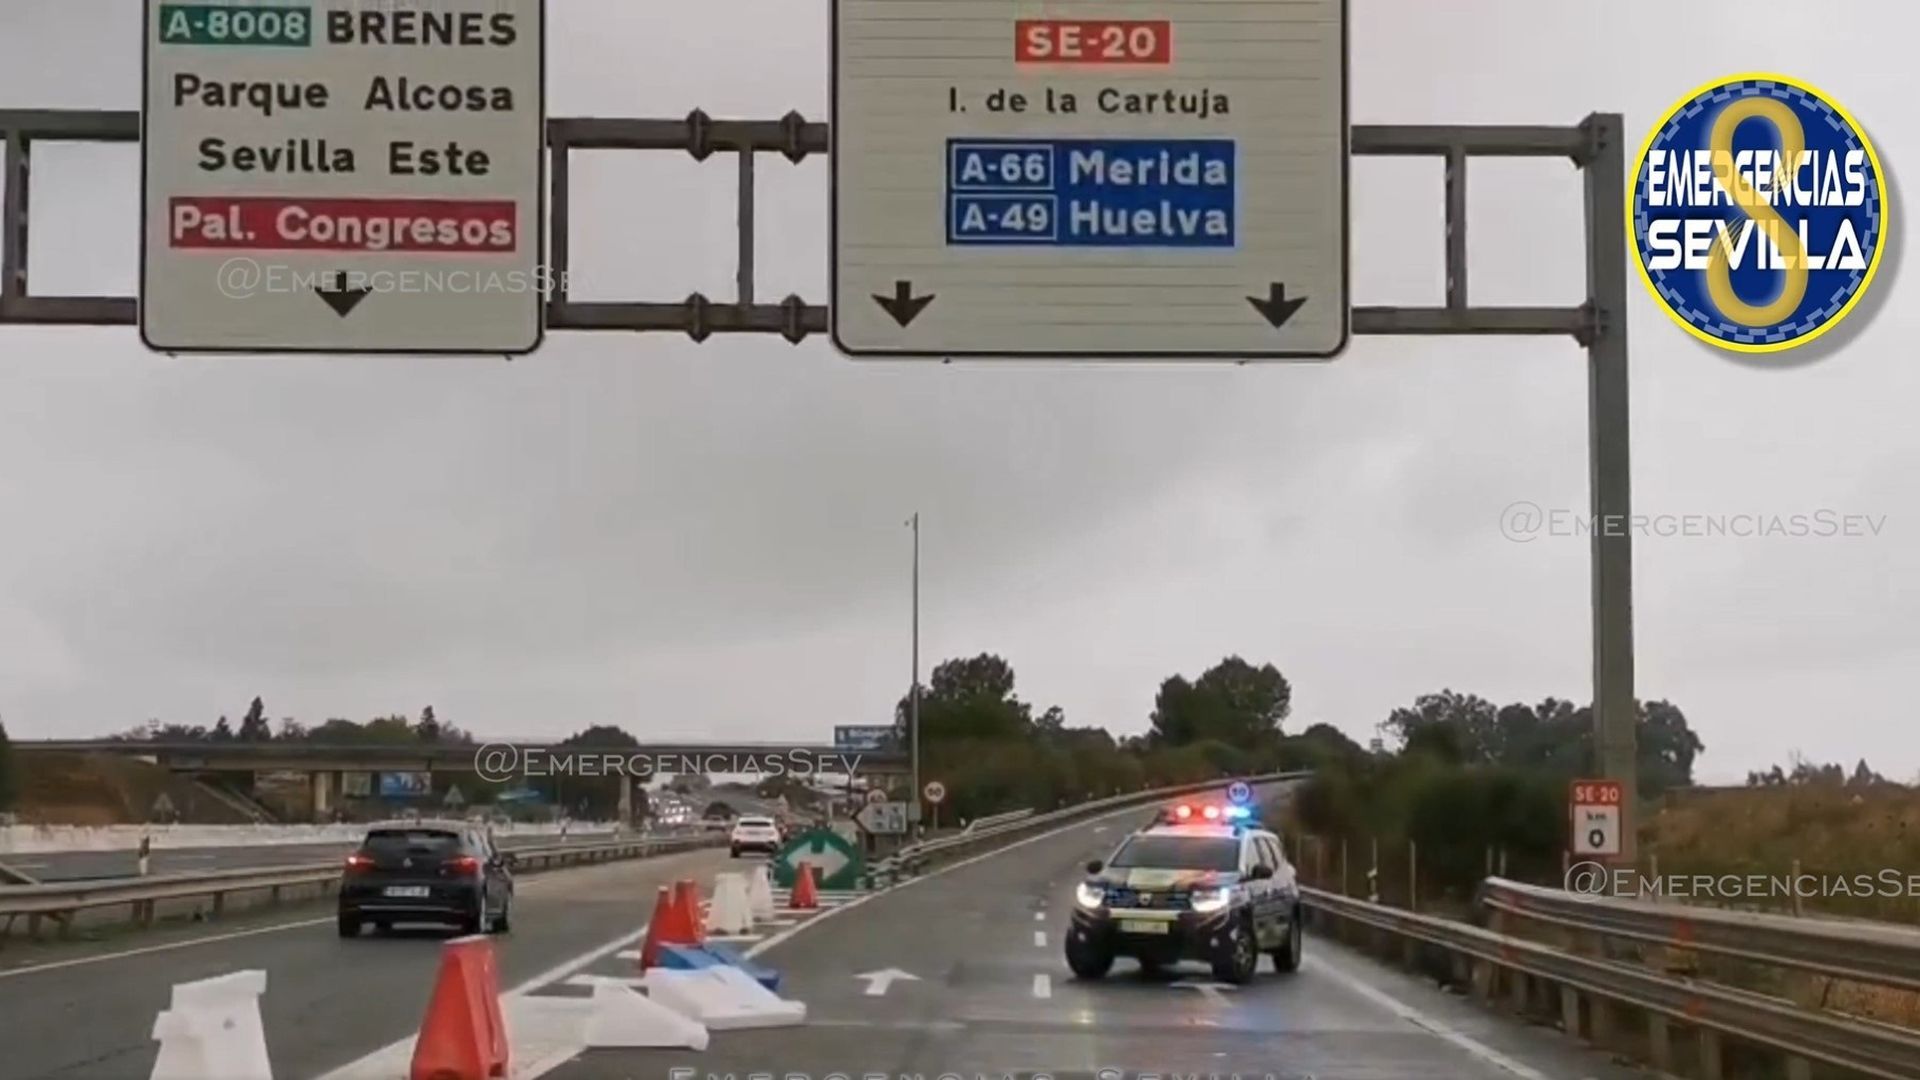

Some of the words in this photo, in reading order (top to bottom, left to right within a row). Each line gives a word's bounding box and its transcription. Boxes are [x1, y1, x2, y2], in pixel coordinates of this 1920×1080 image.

[165, 10, 307, 40] A-8008
[326, 10, 517, 46] BRENES
[1026, 26, 1157, 59] SE-20
[174, 73, 329, 117] Parque
[364, 76, 515, 112] Alcosa
[985, 88, 1028, 113] de
[1046, 88, 1078, 113] la
[1097, 88, 1231, 120] Cartuja
[197, 138, 356, 173] Sevilla
[388, 142, 491, 176] Este
[960, 152, 1046, 183] A-66
[1069, 150, 1228, 187] Merida
[173, 205, 256, 241] Pal.
[275, 206, 513, 250] Congresos
[960, 203, 1050, 232] A-49
[1069, 200, 1229, 237] Huelva
[1575, 785, 1619, 803] SE-20
[1588, 828, 1606, 849] 0
